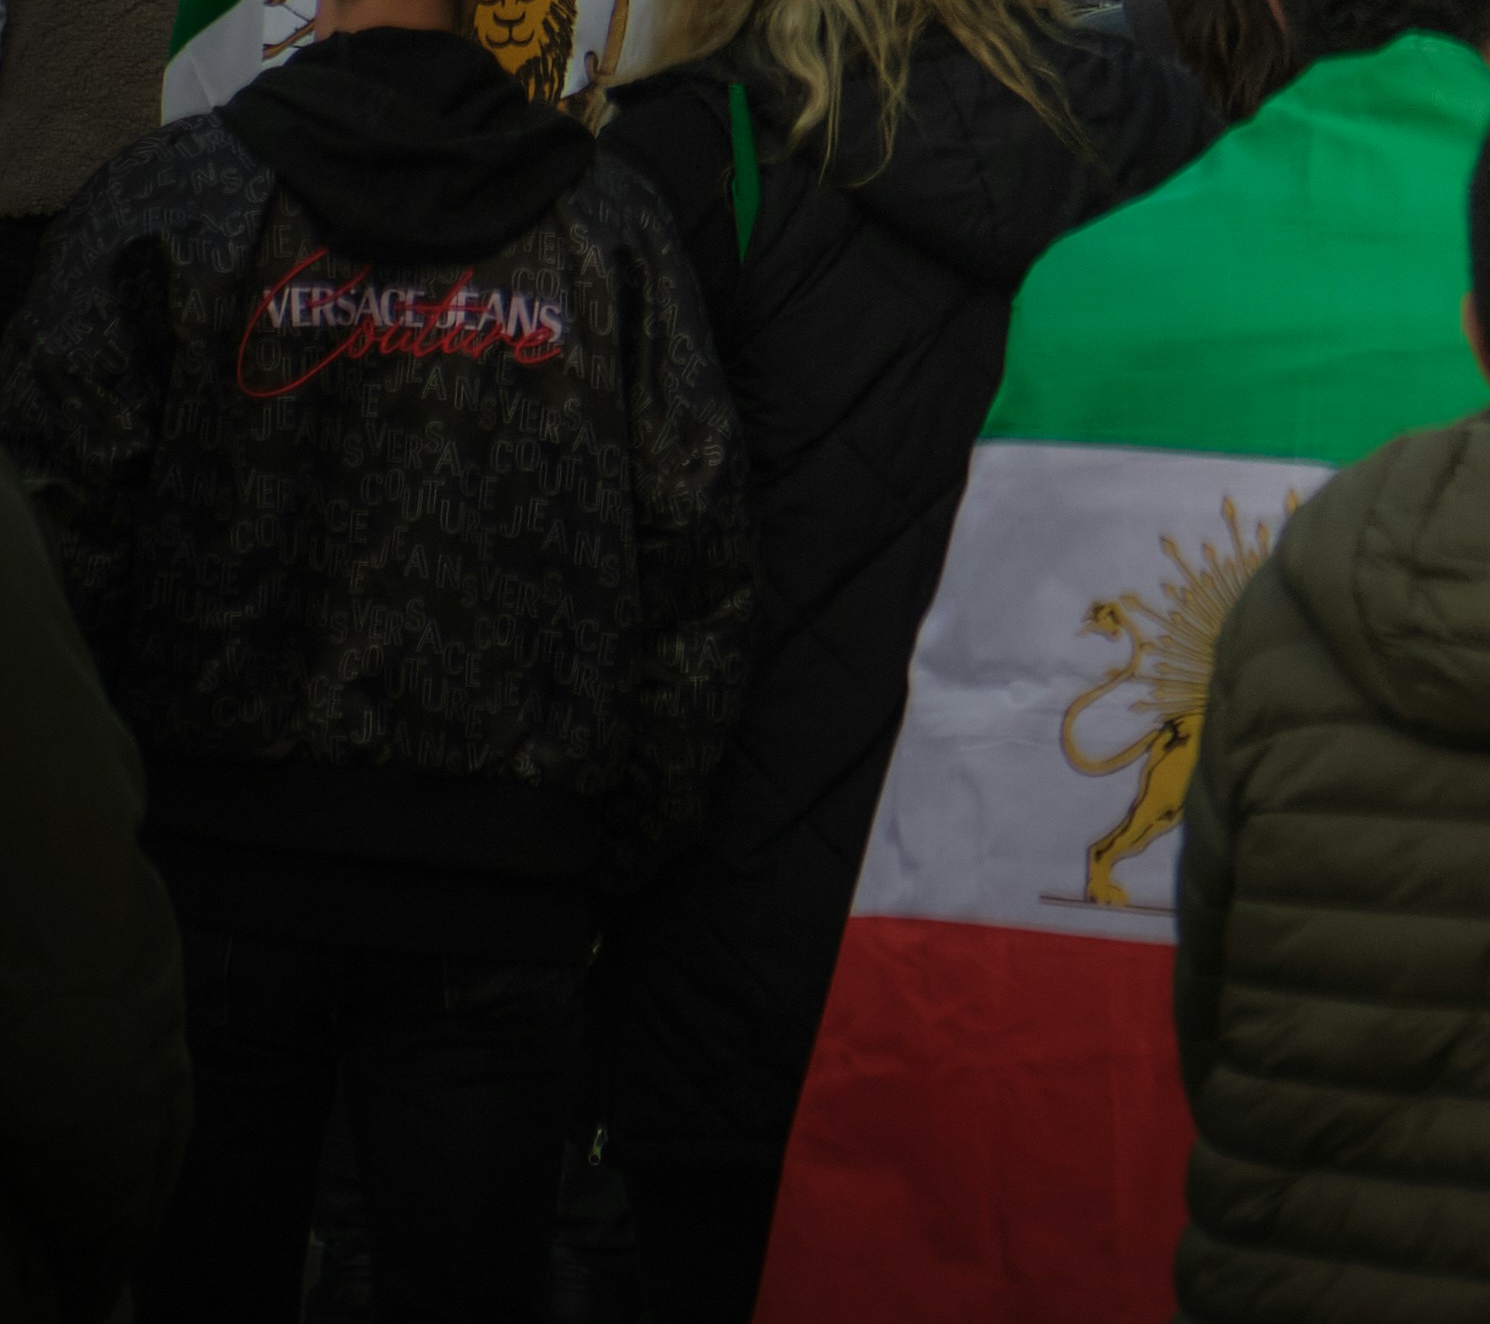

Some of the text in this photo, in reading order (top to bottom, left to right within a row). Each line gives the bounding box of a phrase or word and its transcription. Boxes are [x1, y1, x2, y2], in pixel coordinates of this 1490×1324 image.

[236, 247, 563, 398] Couture
[264, 285, 426, 330] VERSACE
[436, 286, 564, 345] JEANS
